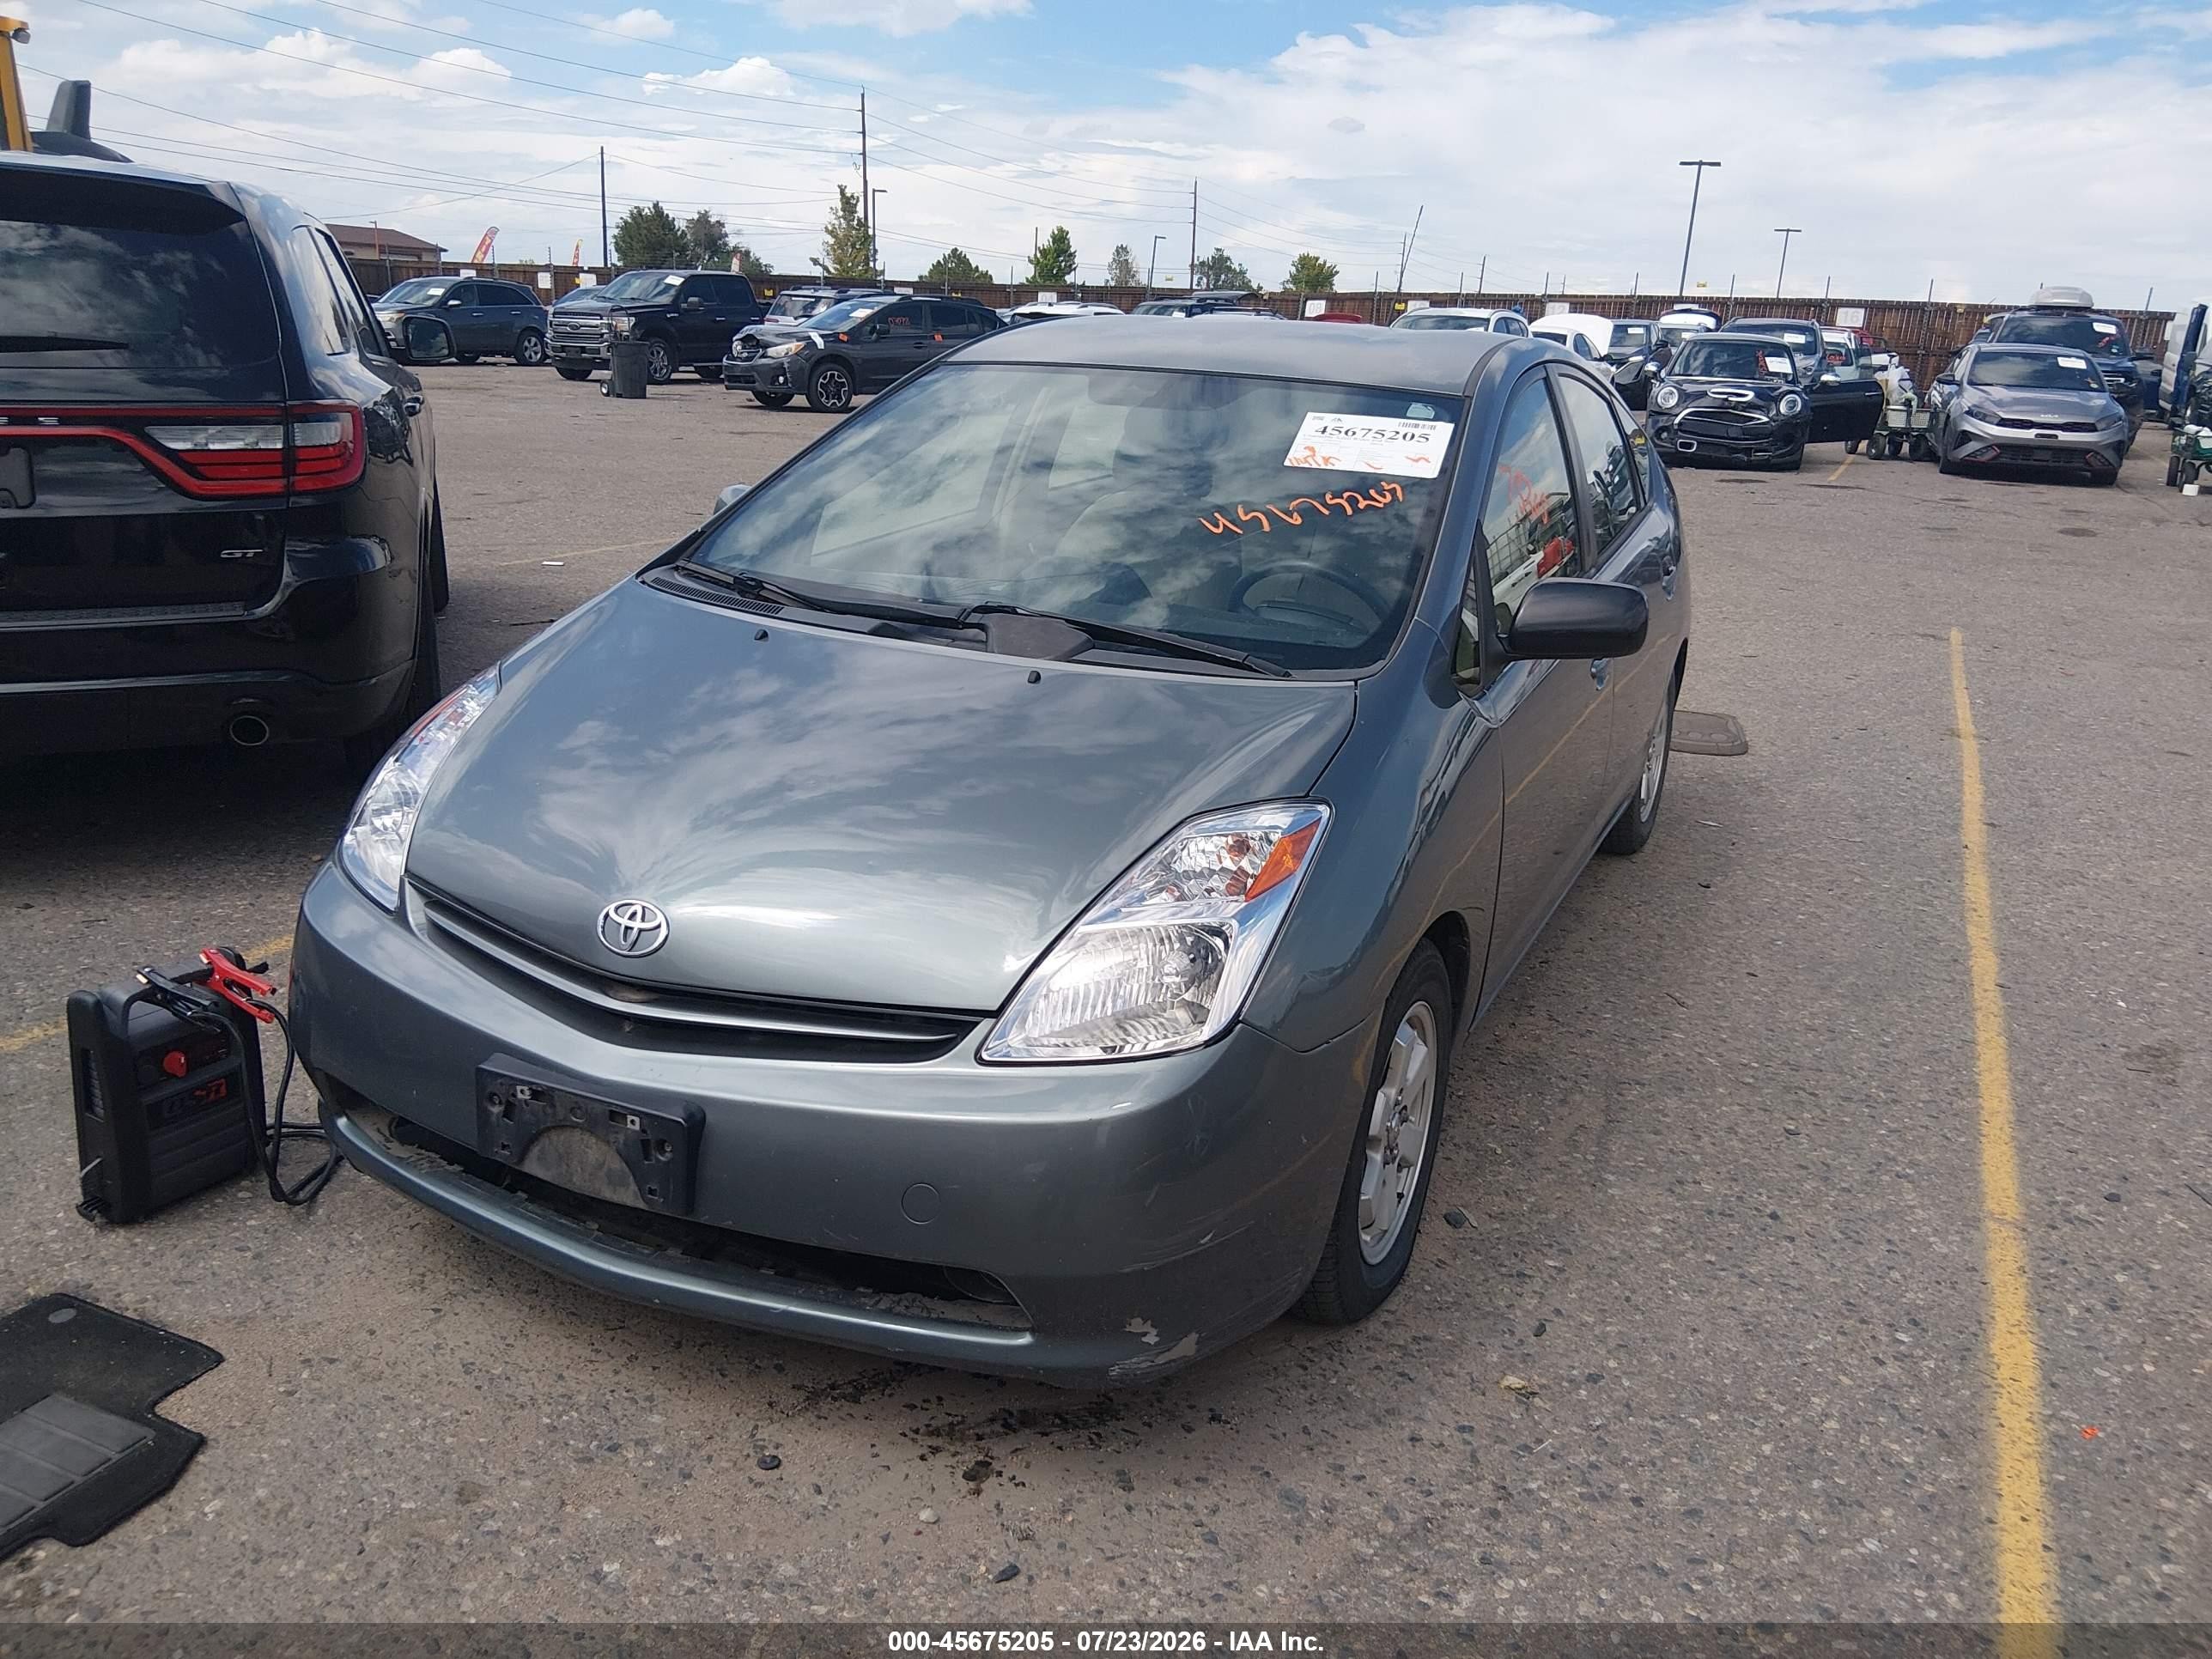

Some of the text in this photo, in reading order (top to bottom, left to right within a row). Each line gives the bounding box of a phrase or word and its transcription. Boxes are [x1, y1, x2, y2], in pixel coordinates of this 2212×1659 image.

[1841, 309, 1861, 324] 16
[1314, 425, 1431, 444] 45675205
[220, 549, 264, 558] GT
